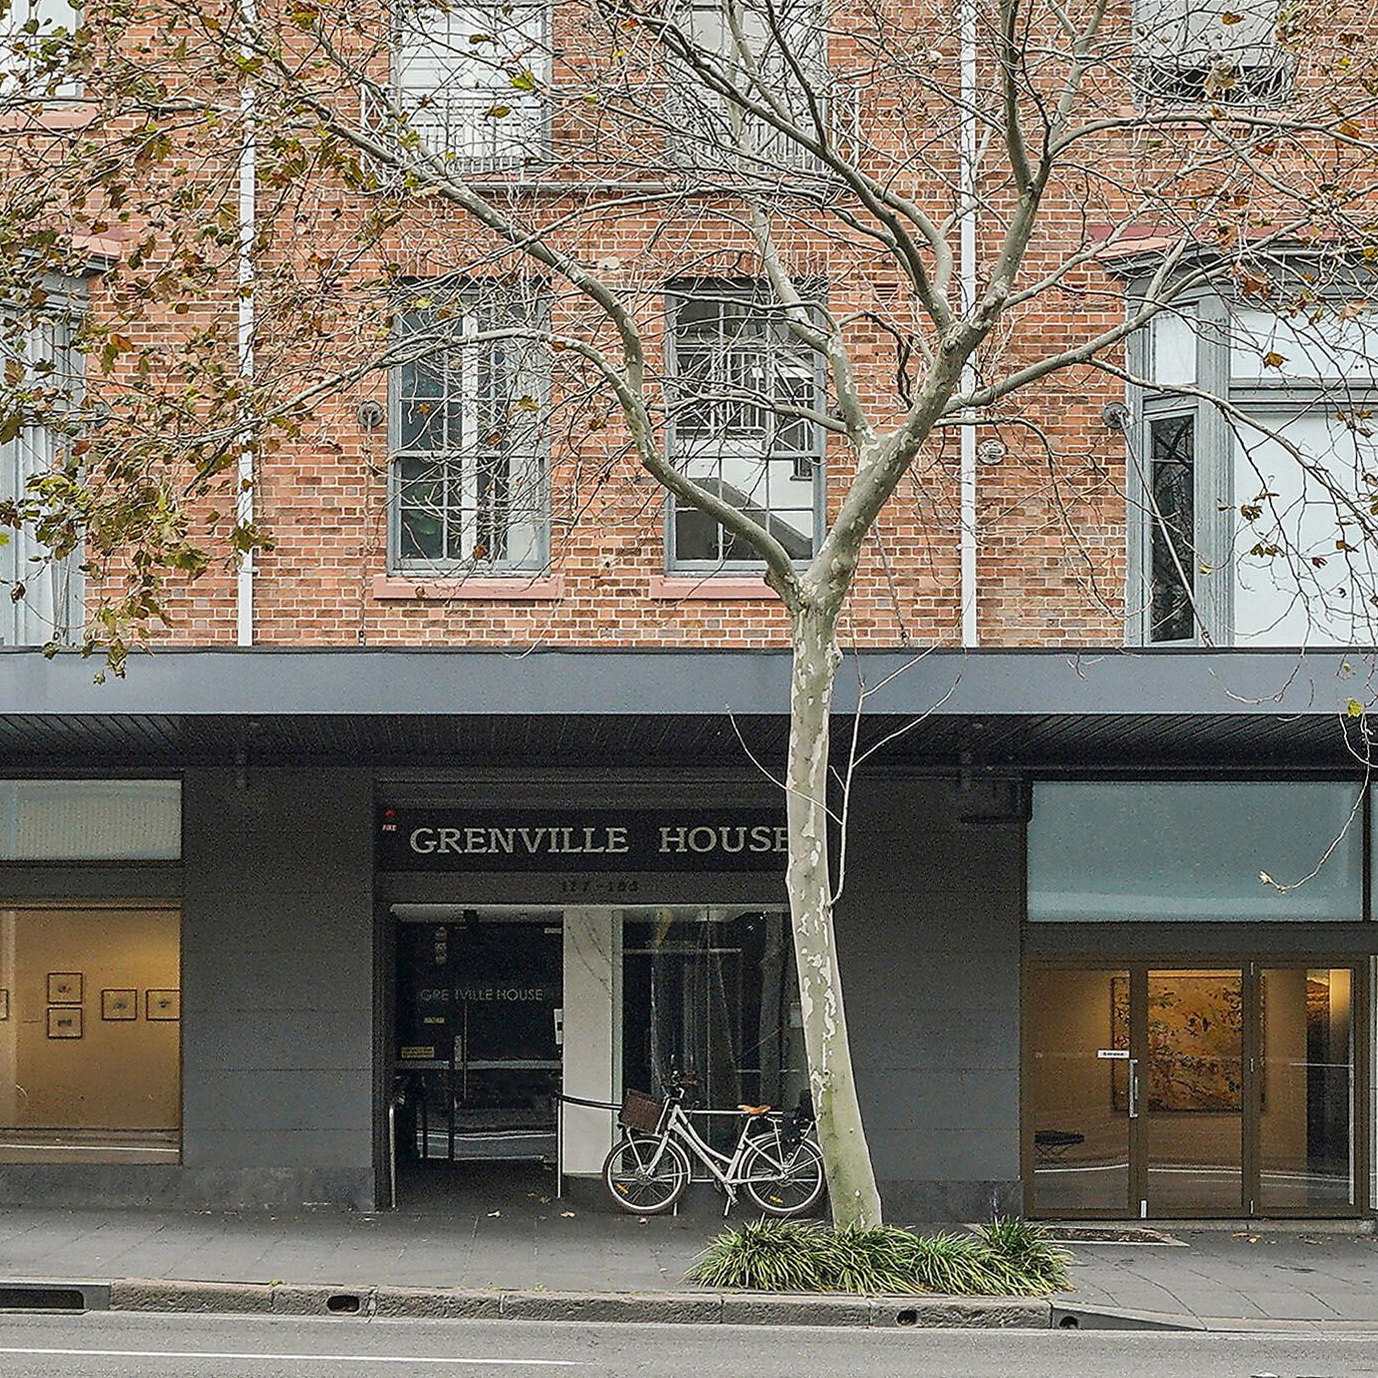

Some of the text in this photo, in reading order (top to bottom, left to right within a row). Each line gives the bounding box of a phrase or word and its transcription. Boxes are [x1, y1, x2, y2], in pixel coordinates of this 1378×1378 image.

[409, 826, 789, 854] GRENVILLE HOUSE
[496, 988, 544, 1001] HOUSE
